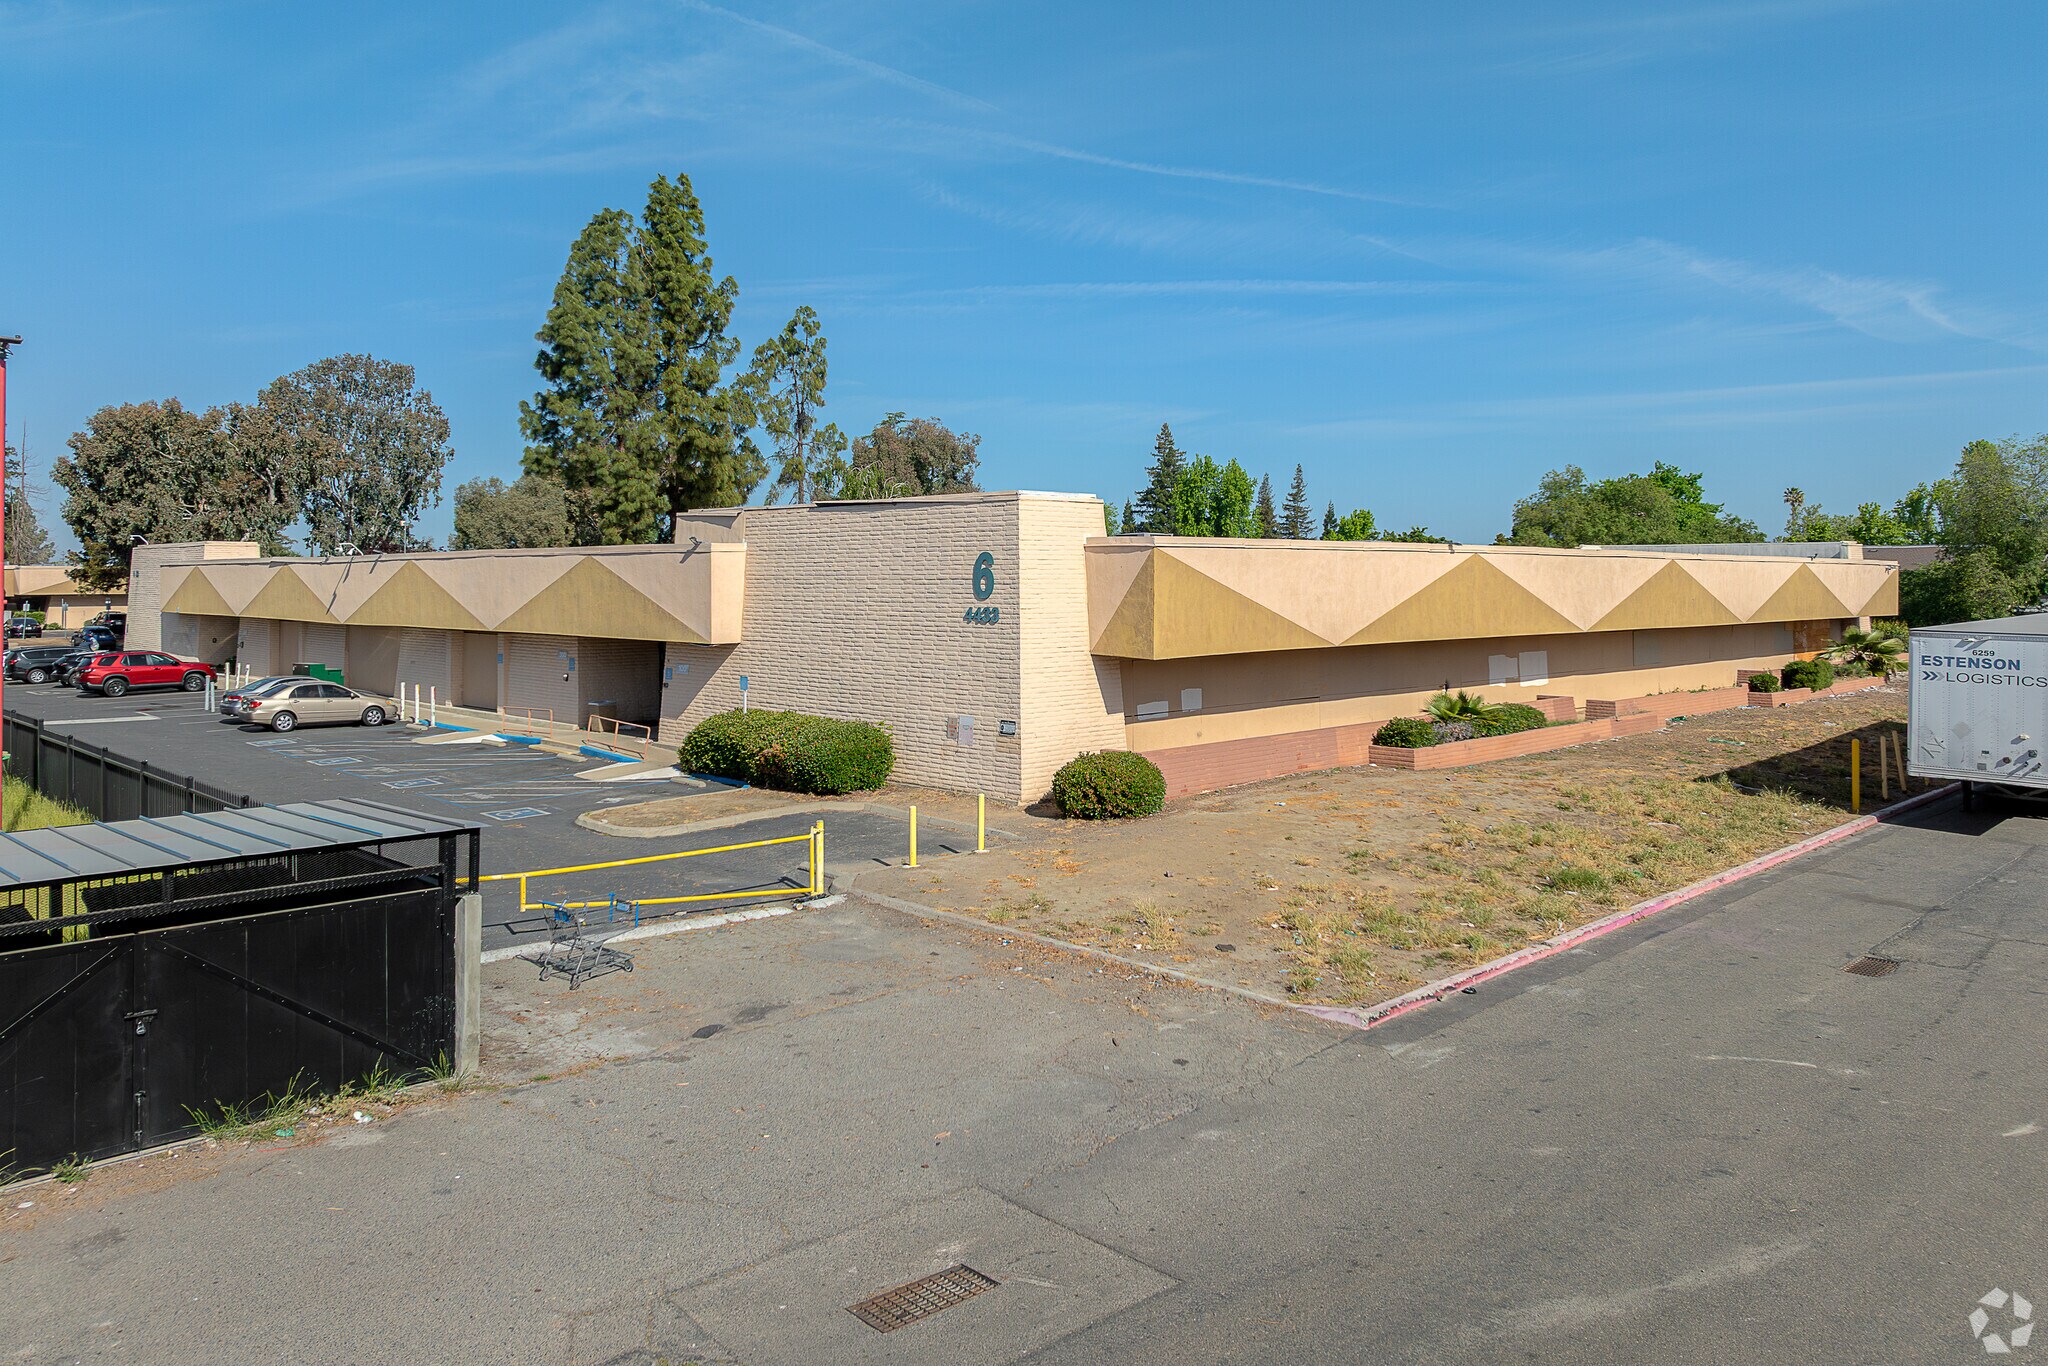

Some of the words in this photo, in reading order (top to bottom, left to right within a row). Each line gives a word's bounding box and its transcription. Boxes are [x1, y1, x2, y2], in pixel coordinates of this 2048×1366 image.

[972, 552, 994, 601] 6
[963, 607, 999, 625] 4433
[1921, 655, 2020, 670] ESTENSON
[1946, 672, 2048, 688] LOGISTICS
